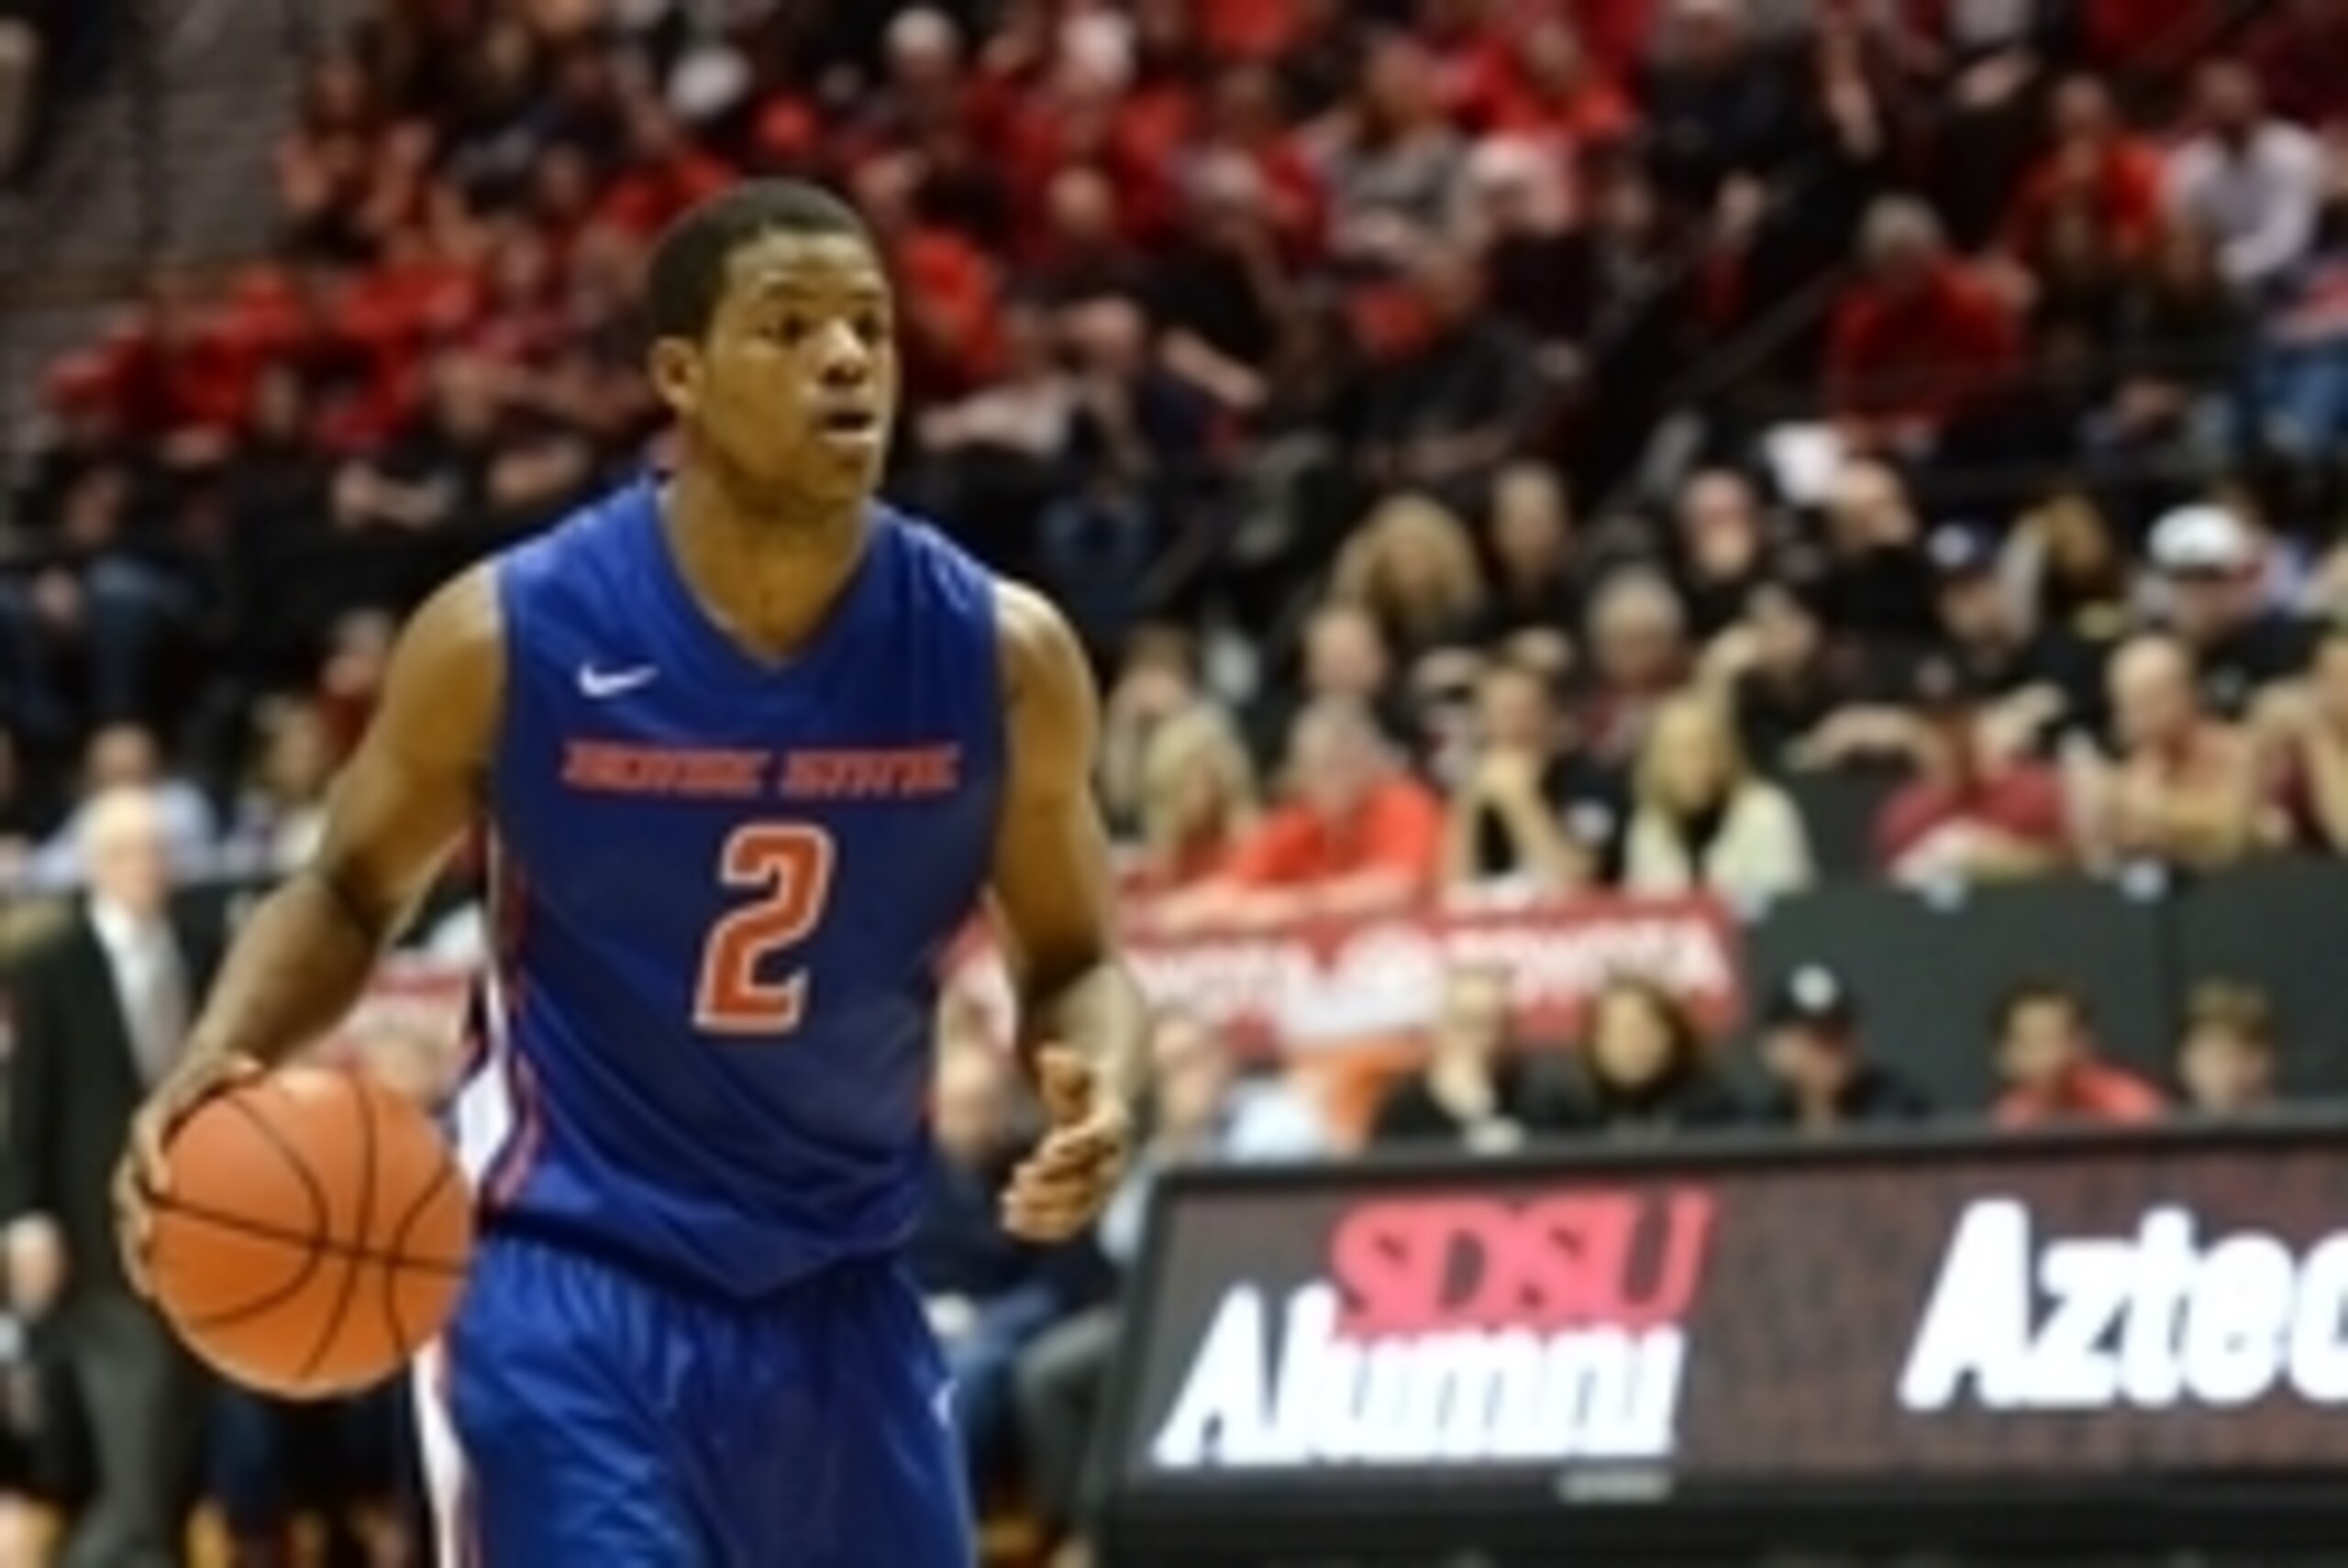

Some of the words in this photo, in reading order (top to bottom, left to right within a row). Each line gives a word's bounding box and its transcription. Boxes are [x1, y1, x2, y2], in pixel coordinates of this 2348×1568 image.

[692, 819, 835, 1034] 2
[1330, 1187, 1713, 1335] SDSU
[1899, 1198, 2348, 1409] Aztec
[1153, 1279, 1686, 1467] Alumni
